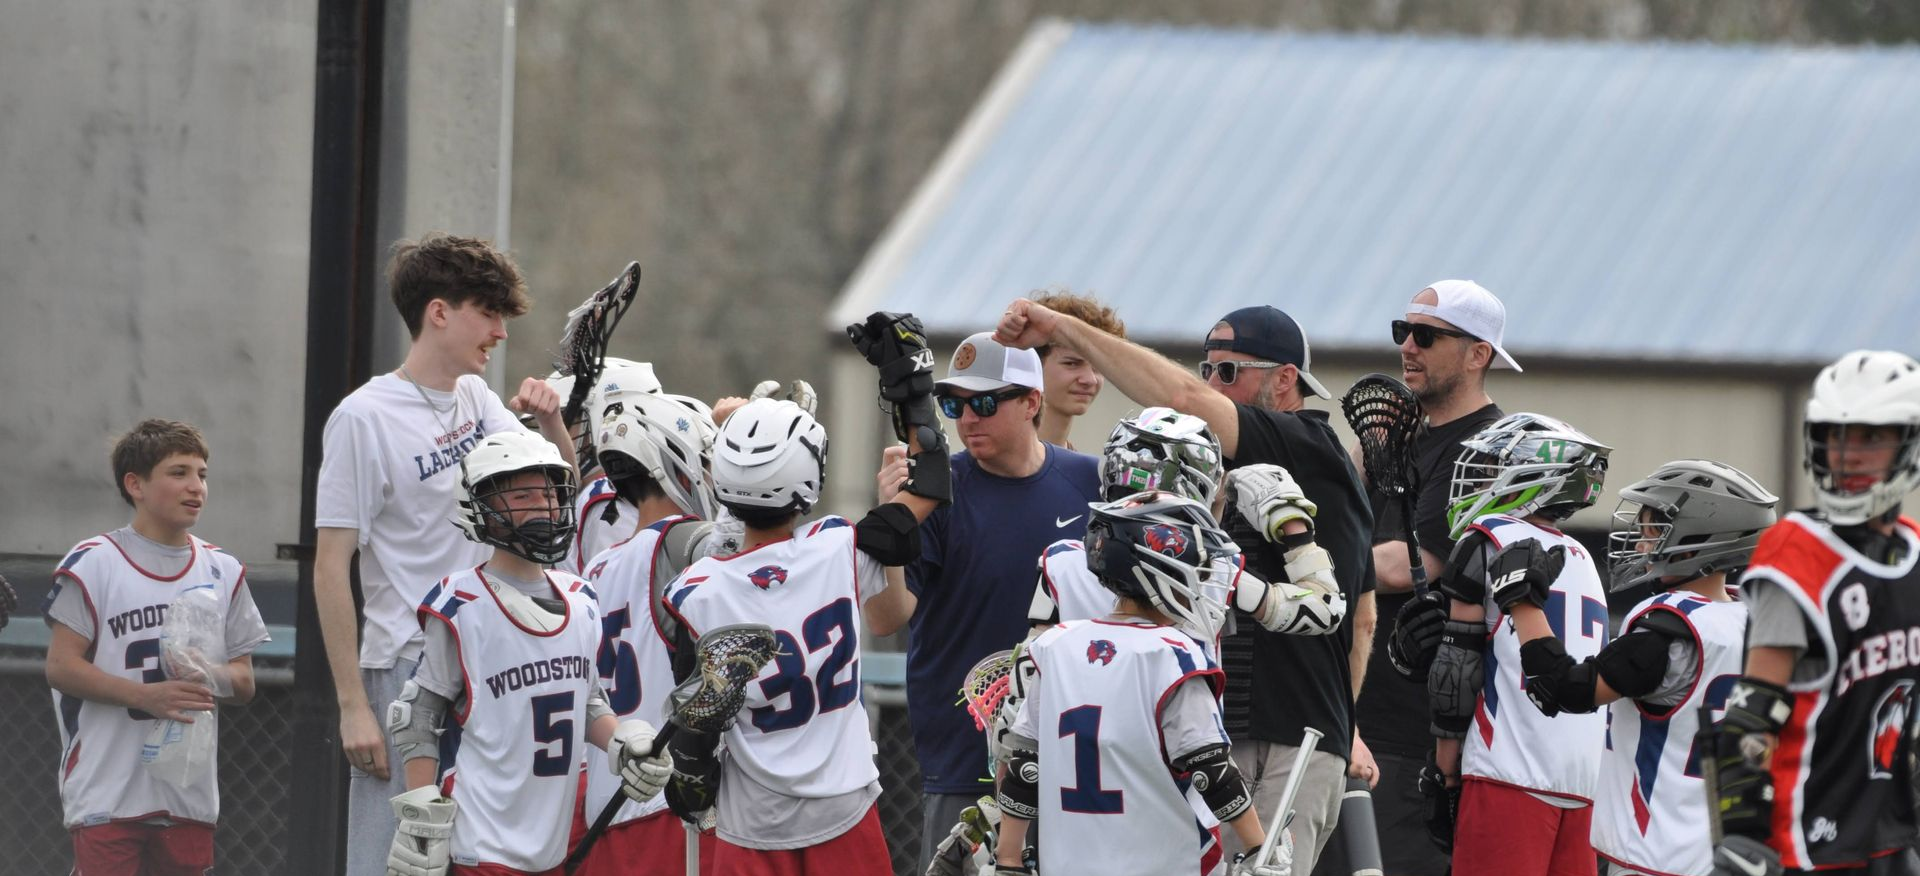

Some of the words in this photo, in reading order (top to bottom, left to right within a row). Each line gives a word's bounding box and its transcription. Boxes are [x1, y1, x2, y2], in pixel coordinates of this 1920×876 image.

[1535, 440, 1567, 463] 47
[1841, 582, 1870, 631] 8
[745, 597, 859, 733] 32
[531, 690, 575, 777] 5
[1059, 704, 1125, 814] 1
